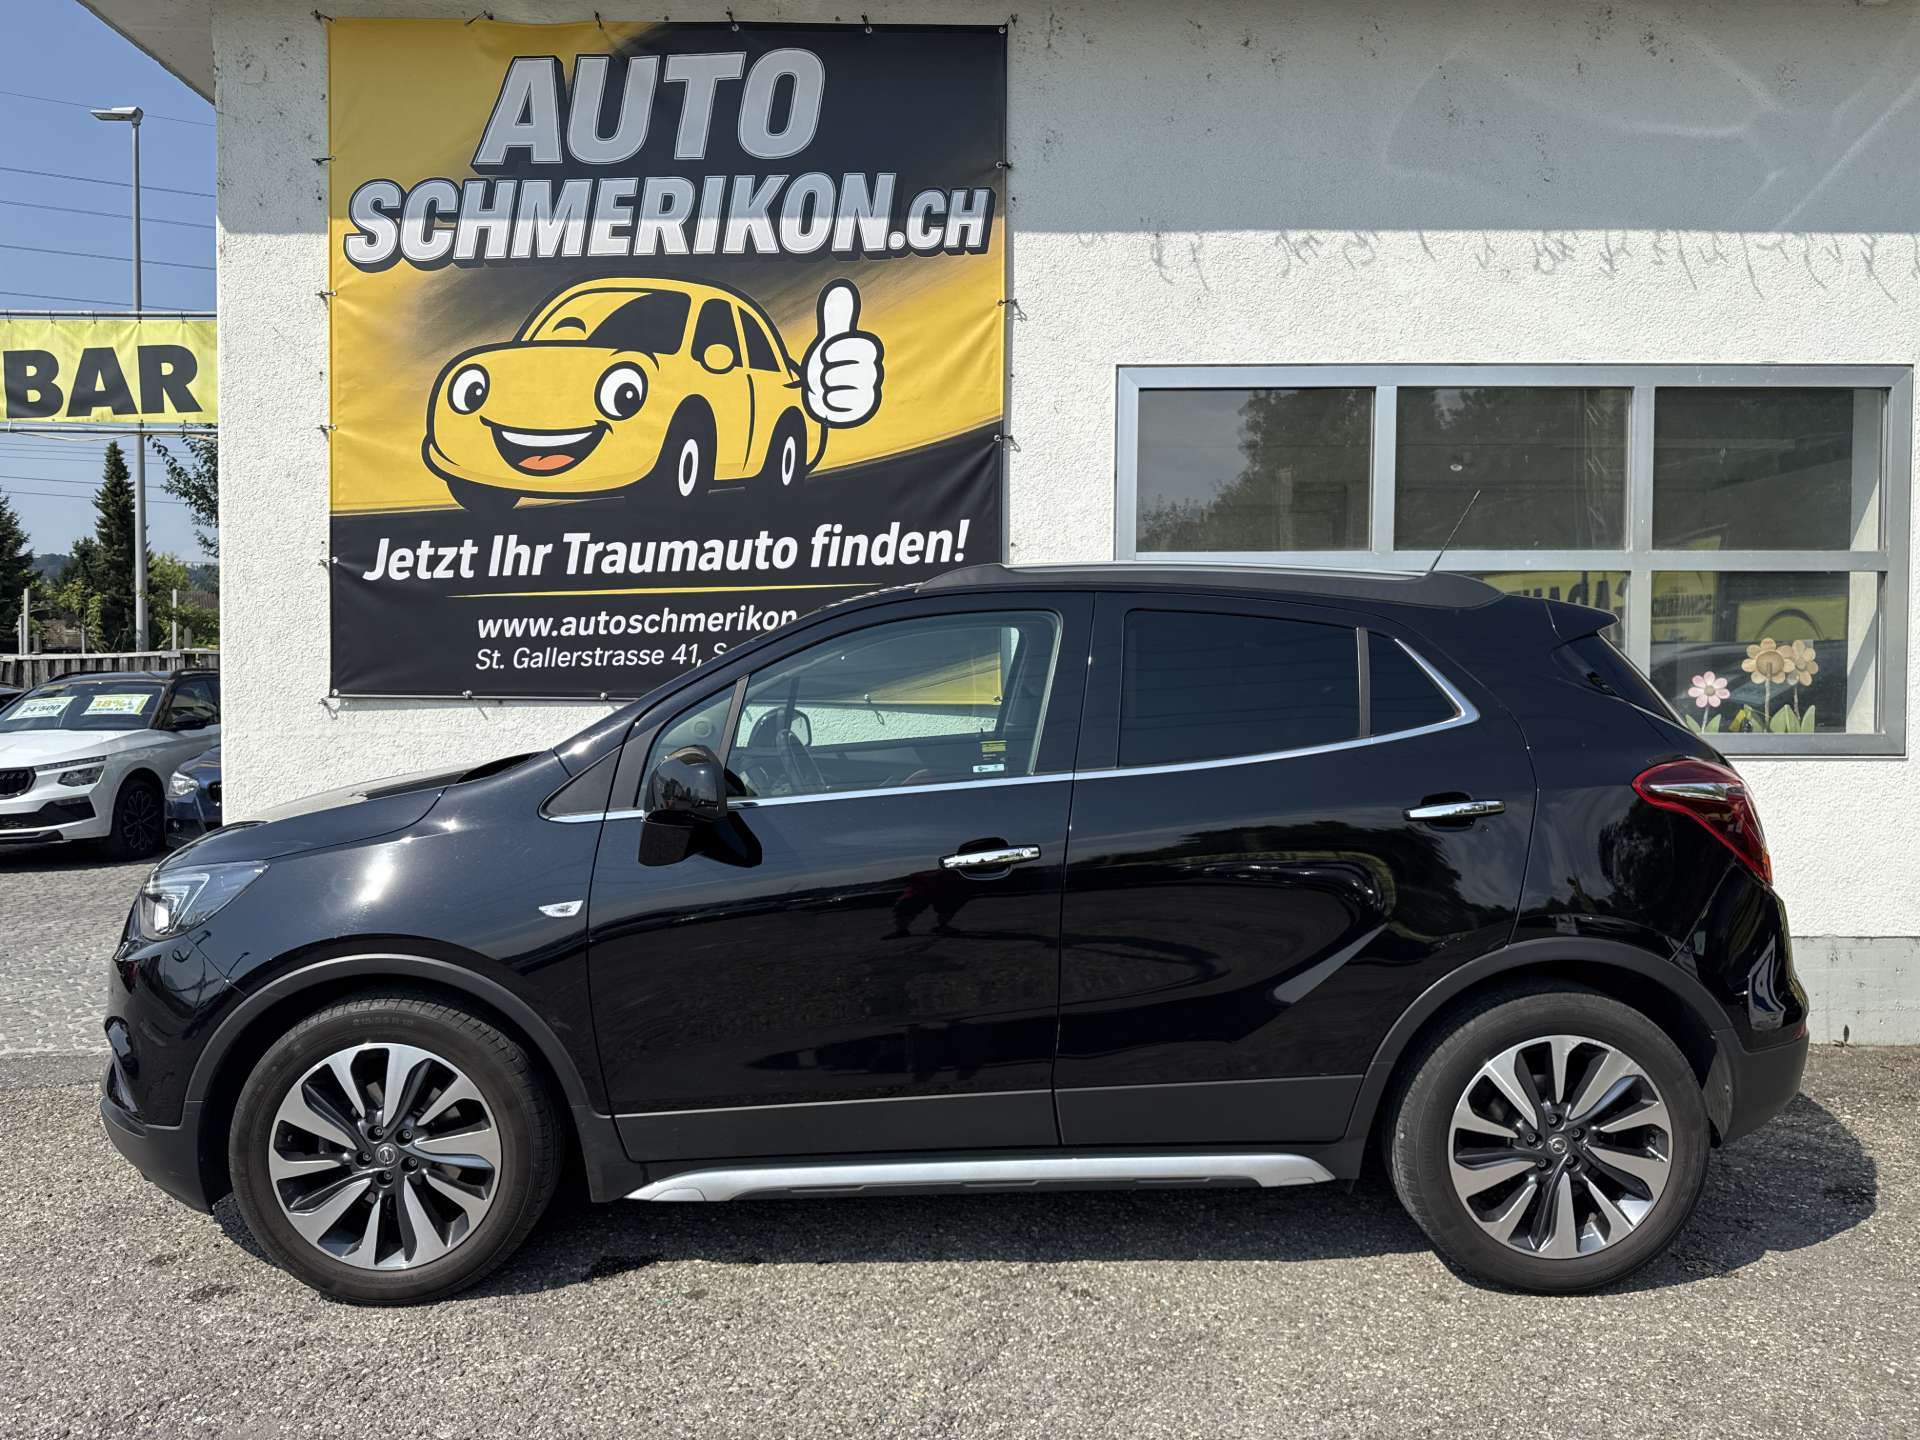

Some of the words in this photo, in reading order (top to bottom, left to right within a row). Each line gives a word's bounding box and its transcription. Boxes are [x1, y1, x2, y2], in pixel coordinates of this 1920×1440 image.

[472, 48, 825, 167] AUTO
[345, 172, 989, 265] SCHMERIKON.CH
[3, 344, 204, 418] BAR
[363, 538, 479, 580] Jetzt
[488, 535, 553, 576] Ihr
[562, 531, 798, 574] Traumauto
[810, 519, 970, 567] finden!
[475, 648, 505, 670] St.
[513, 644, 664, 669] Gallerstrasse
[671, 643, 702, 668] 41,
